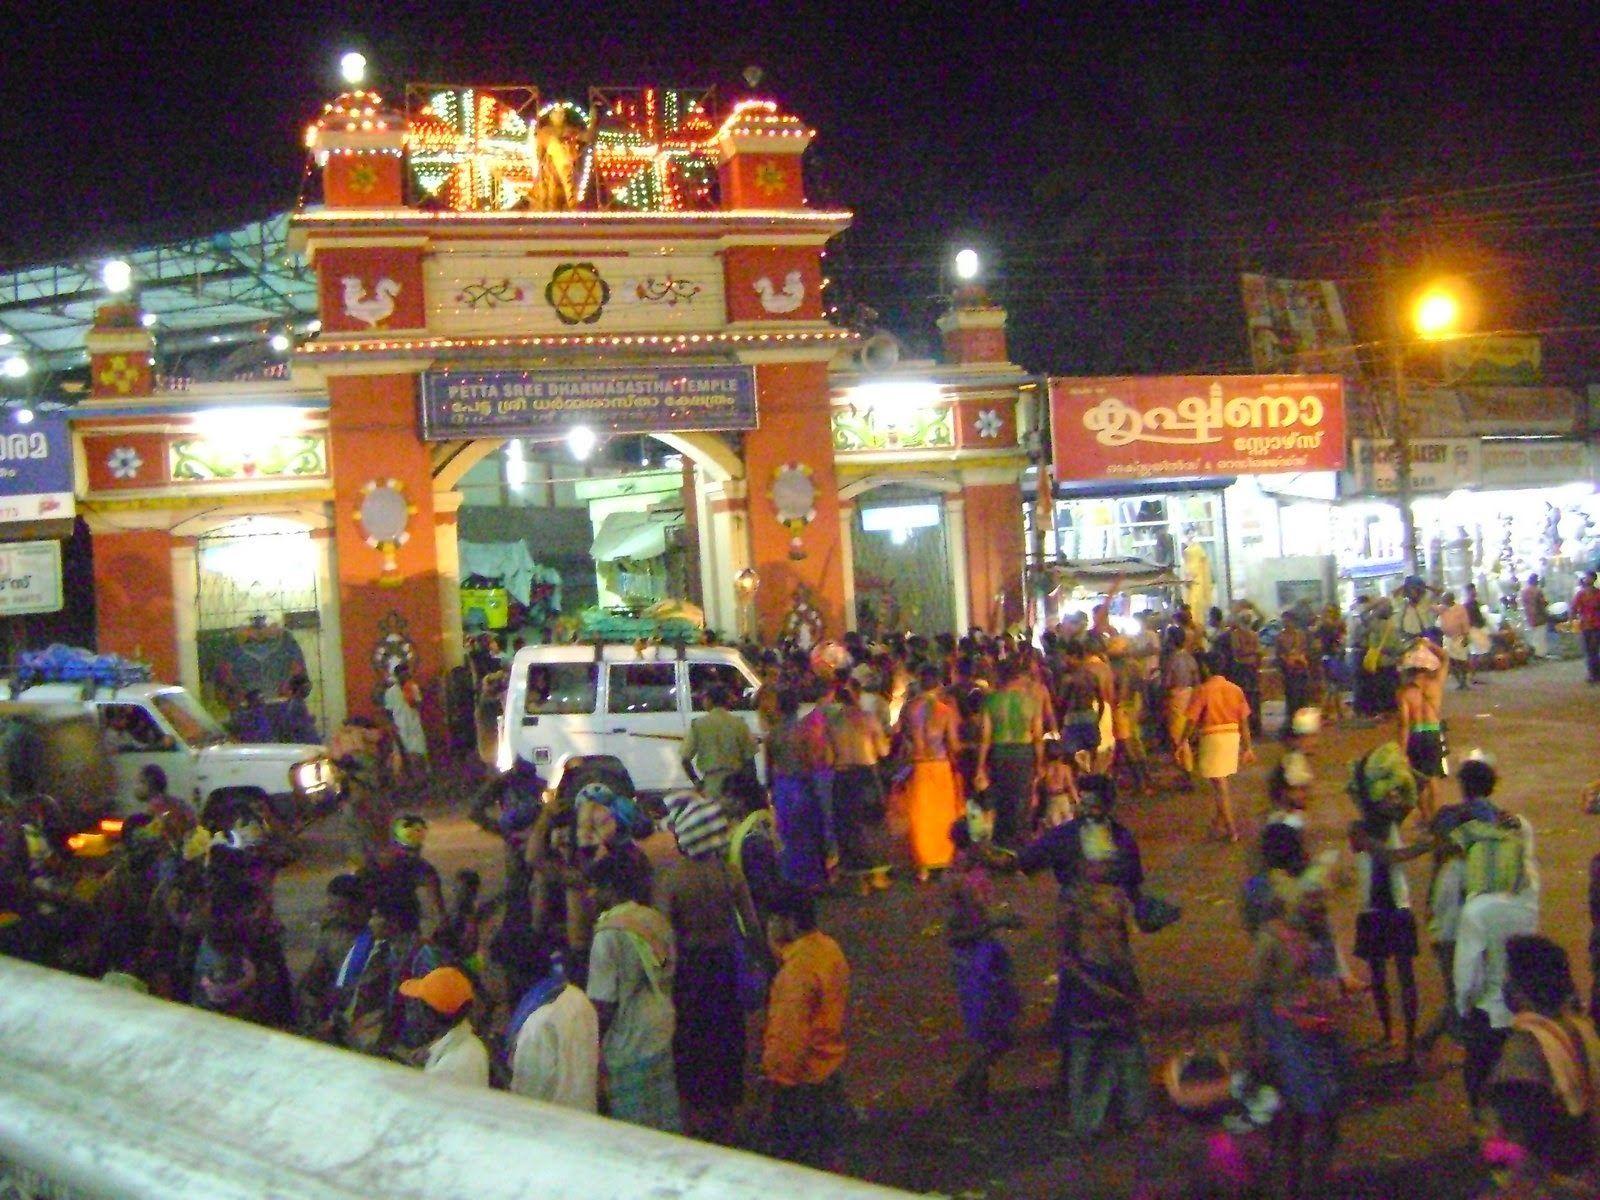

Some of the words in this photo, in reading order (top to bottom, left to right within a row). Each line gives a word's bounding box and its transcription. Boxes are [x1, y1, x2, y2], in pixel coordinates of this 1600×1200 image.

[448, 384, 498, 398] PETTA
[502, 383, 543, 397] SREE
[548, 379, 674, 396] DHARMASASTHA
[680, 377, 738, 393] TEMPLE
[1083, 381, 1324, 446] കൃഷ്ണാ
